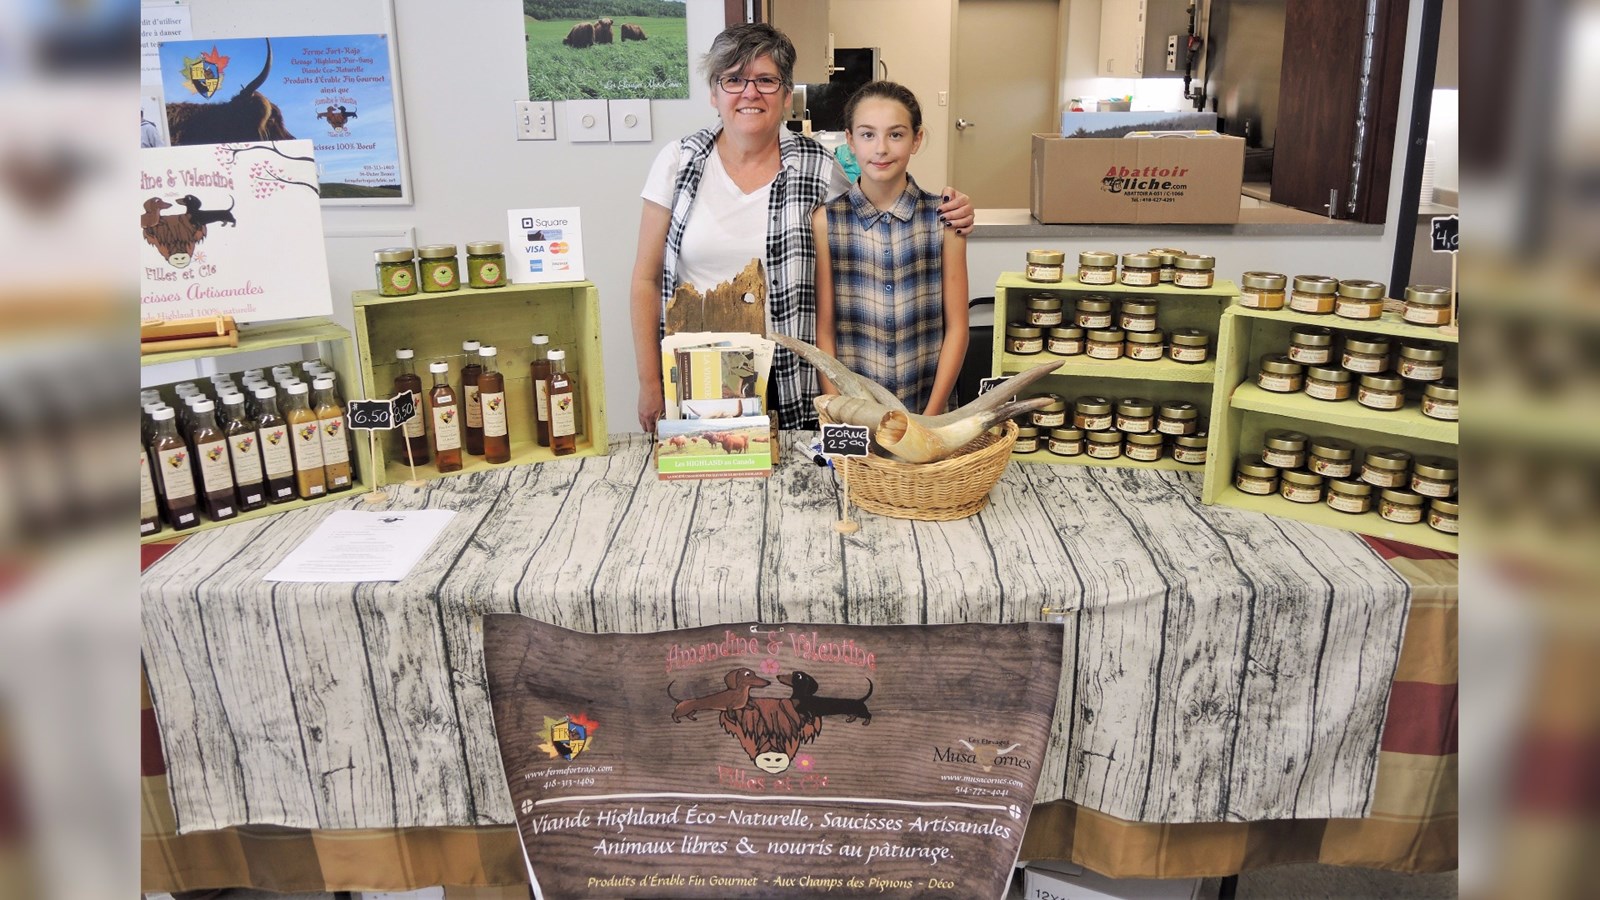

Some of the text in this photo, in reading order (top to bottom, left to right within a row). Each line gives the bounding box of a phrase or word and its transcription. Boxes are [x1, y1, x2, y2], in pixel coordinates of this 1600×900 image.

[302, 48, 324, 56] Ferme
[314, 56, 342, 65] Highland
[284, 76, 312, 84] Produits
[342, 76, 356, 84] Fin
[336, 142, 355, 150] 100%
[167, 168, 177, 188] &
[178, 168, 234, 190] Valentine
[1106, 166, 1189, 177] Abattoir
[535, 218, 568, 228] Square
[146, 267, 178, 282] Filles
[182, 268, 194, 280] et
[186, 280, 264, 301] Artisanales
[198, 308, 220, 316] 100%
[222, 304, 257, 315] naturelle
[354, 410, 388, 424] 6.50
[826, 429, 867, 440] CORNE
[665, 630, 877, 673] Amandine & Valentine
[932, 746, 977, 764] Musa
[524, 764, 613, 780] www.fermefortrajo.com
[718, 765, 765, 792] Filles
[774, 776, 792, 791] et
[940, 774, 1024, 789] www.musacornes.com
[955, 786, 1009, 796] 514-772-4041
[532, 804, 1012, 839] Viande Highland Éco-Naturelle, Saucisses Artisanales
[593, 836, 954, 865] Animaux libres & nourris au pâturage.
[588, 874, 636, 888] Produits
[639, 873, 686, 887] d'Érable
[688, 875, 705, 886] Fin
[709, 875, 758, 887] Gourmet
[773, 876, 796, 887] Aux
[799, 876, 843, 890] Champs
[847, 876, 865, 888] des
[868, 876, 913, 893] Pignons
[928, 876, 954, 889] Déco
